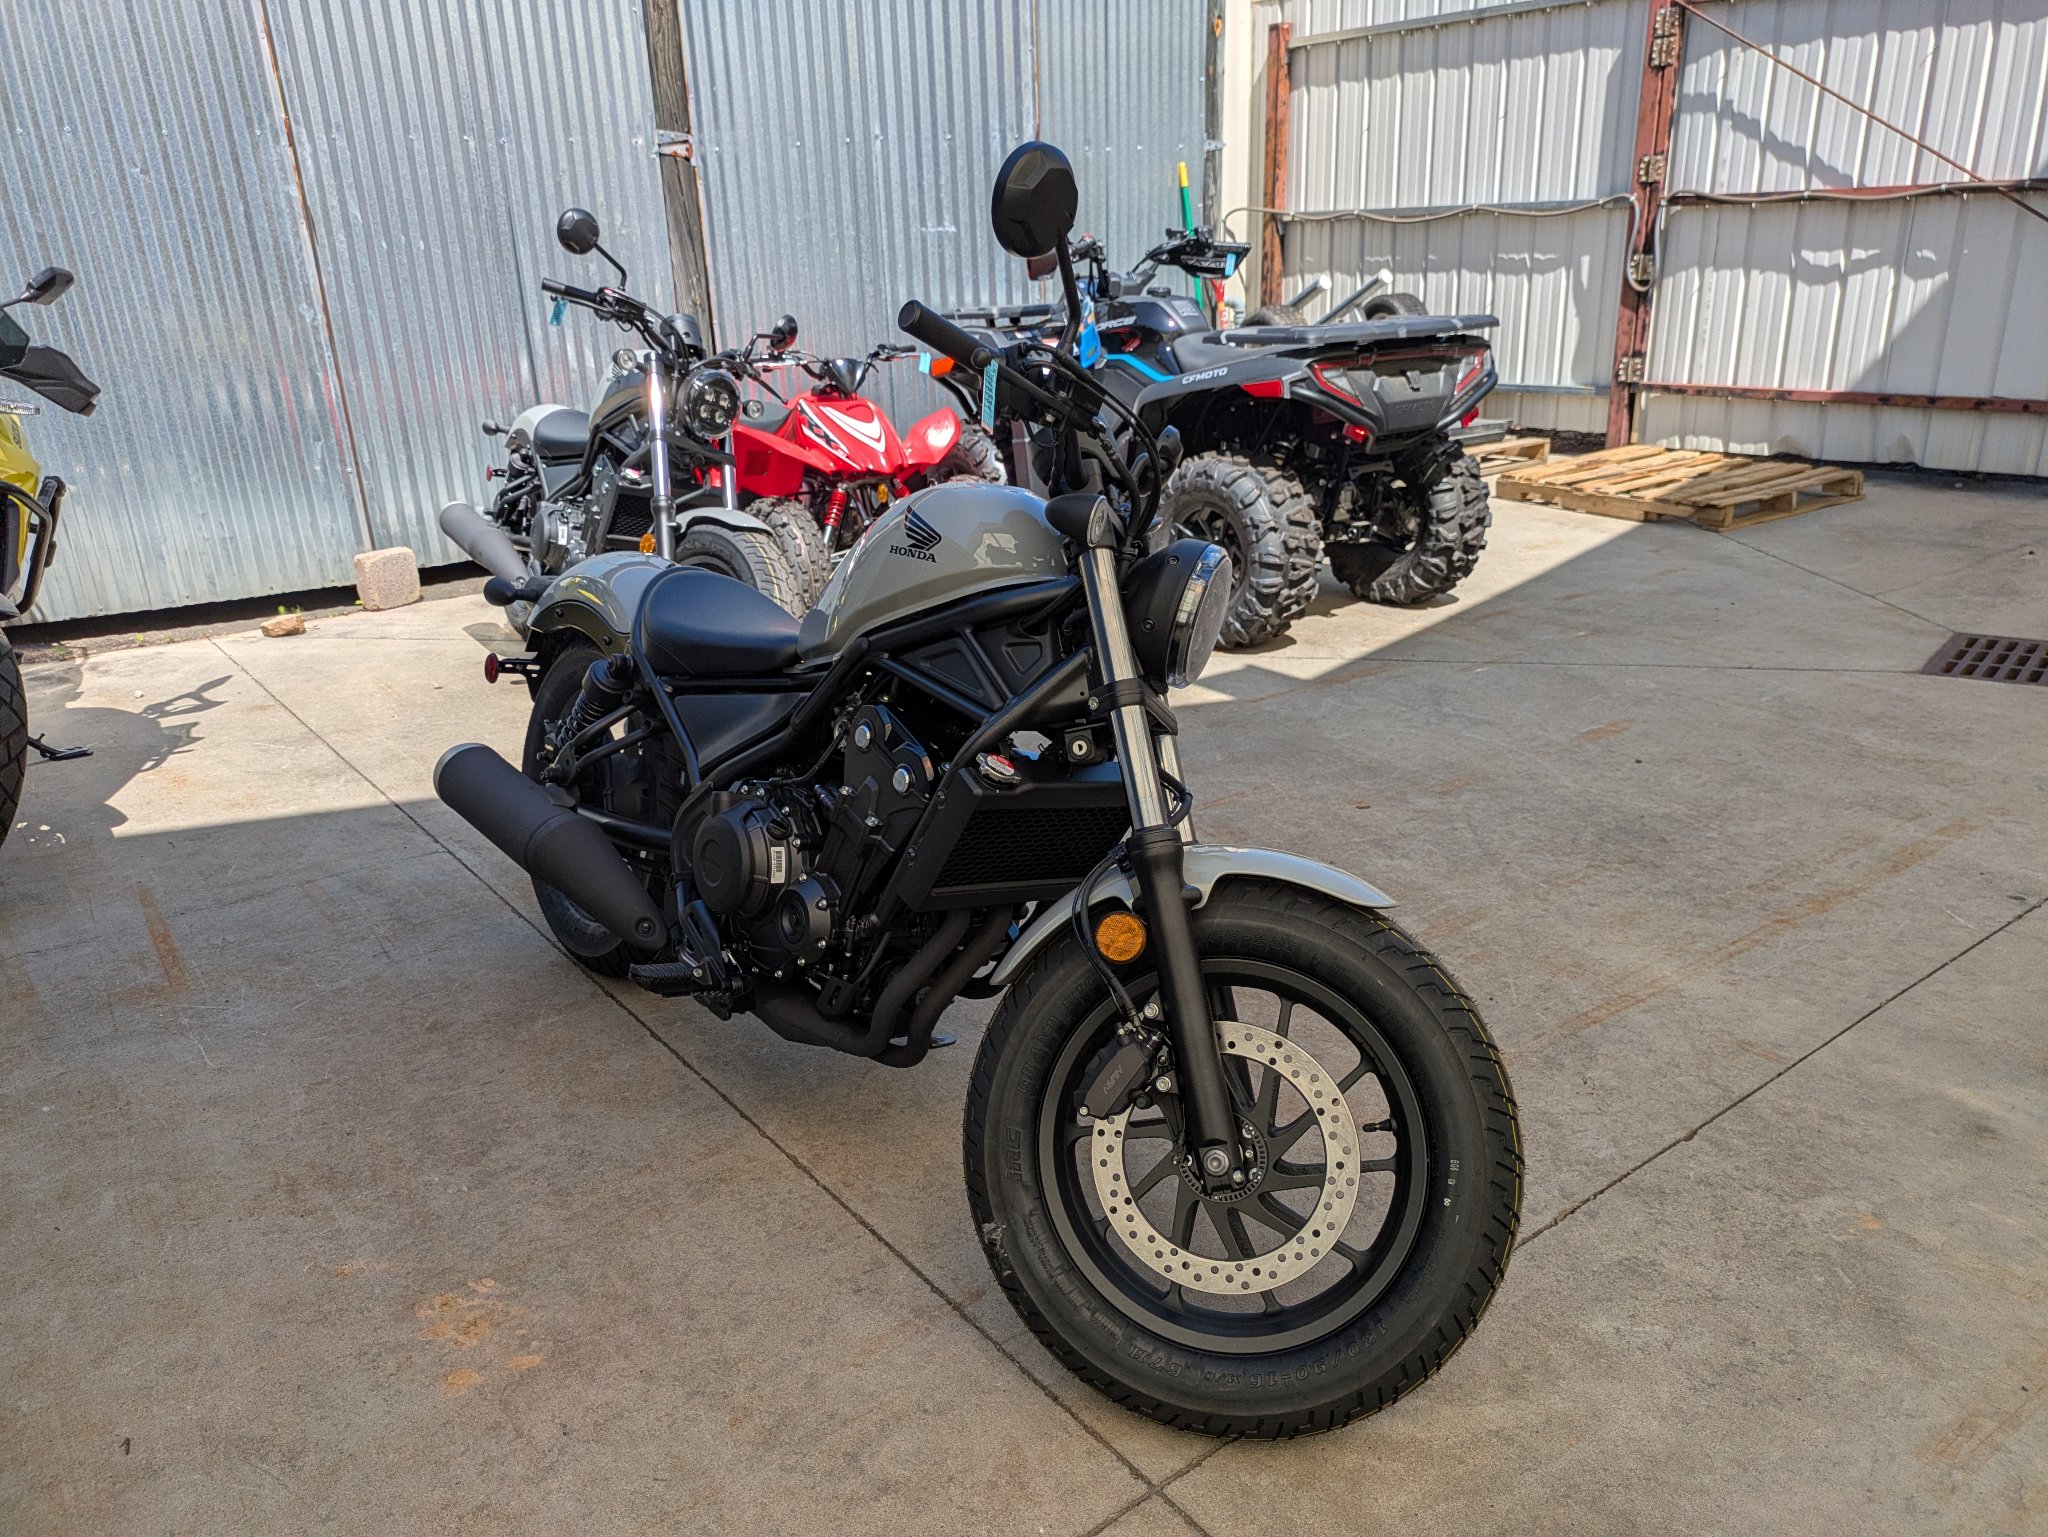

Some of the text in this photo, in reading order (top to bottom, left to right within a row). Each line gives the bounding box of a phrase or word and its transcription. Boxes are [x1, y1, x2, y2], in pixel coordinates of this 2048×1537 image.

[1096, 315, 1137, 331] ORCE
[1182, 367, 1228, 385] CFMOTO
[889, 545, 937, 563] HONDA
[1128, 1344, 1185, 1378] 67H
